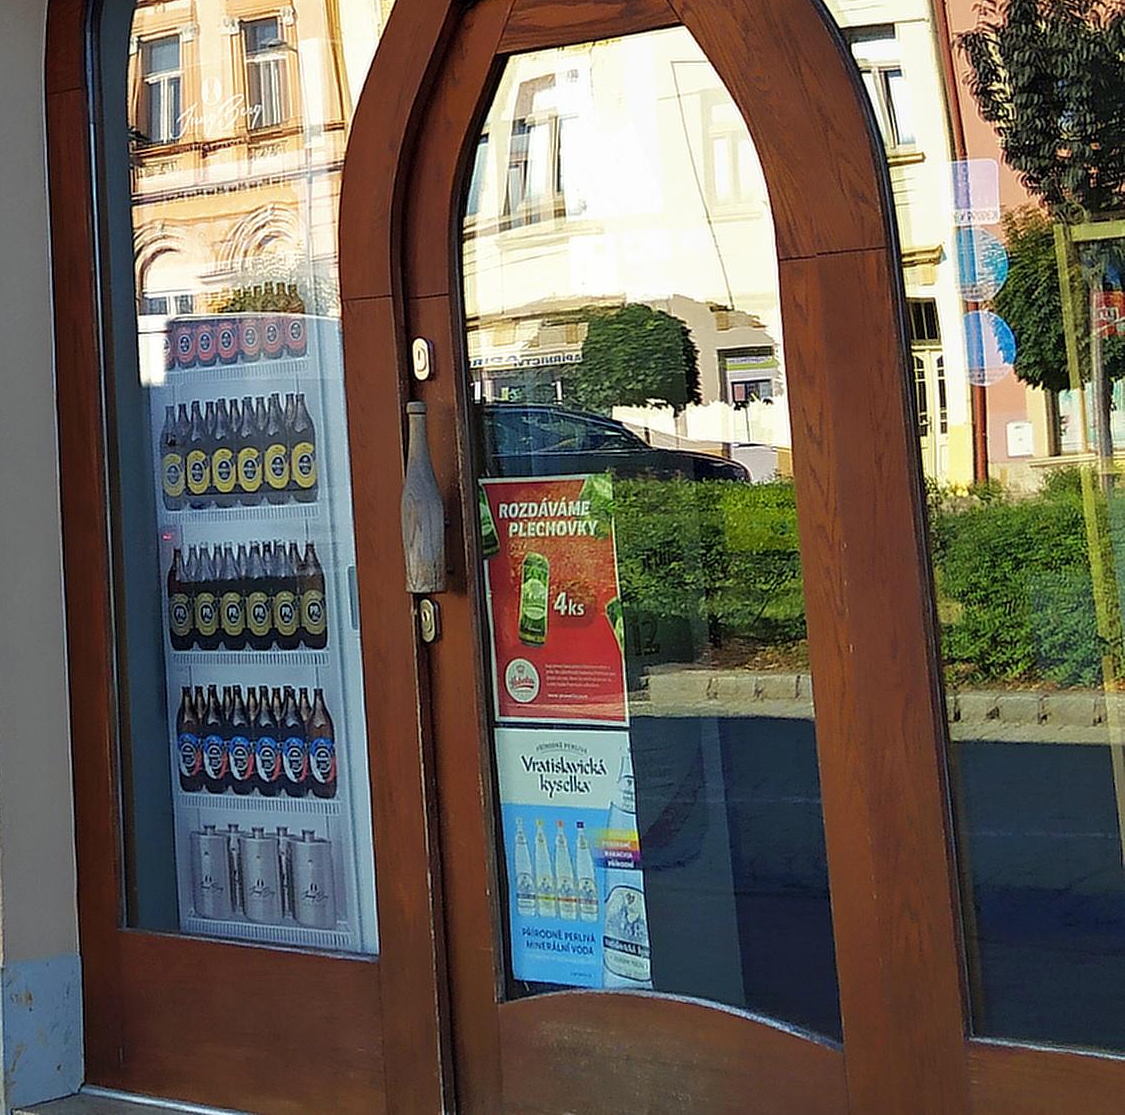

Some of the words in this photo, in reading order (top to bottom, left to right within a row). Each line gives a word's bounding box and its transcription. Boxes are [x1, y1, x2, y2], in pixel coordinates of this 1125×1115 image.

[498, 496, 592, 519] ROZDÁVÁME
[508, 519, 599, 538] PLECHOVKY
[521, 755, 607, 775] Vratislavická
[540, 774, 590, 798] kyselka
